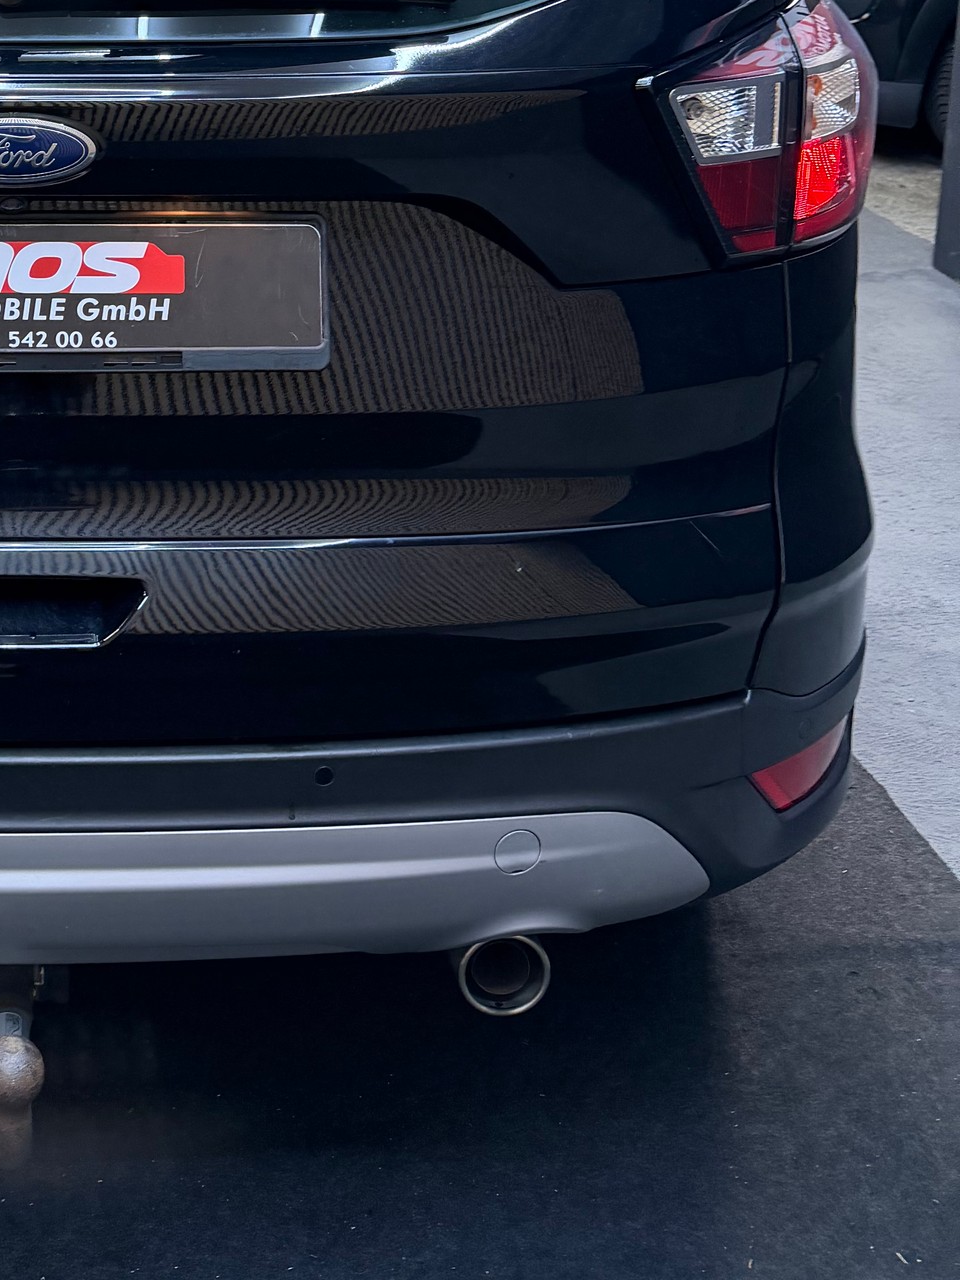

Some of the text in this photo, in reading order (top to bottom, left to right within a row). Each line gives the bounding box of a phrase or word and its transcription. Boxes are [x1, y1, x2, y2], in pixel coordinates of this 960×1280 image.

[76, 297, 170, 321] GmbH
[8, 331, 48, 348] 542
[55, 331, 83, 348] 00
[90, 331, 118, 348] 66
